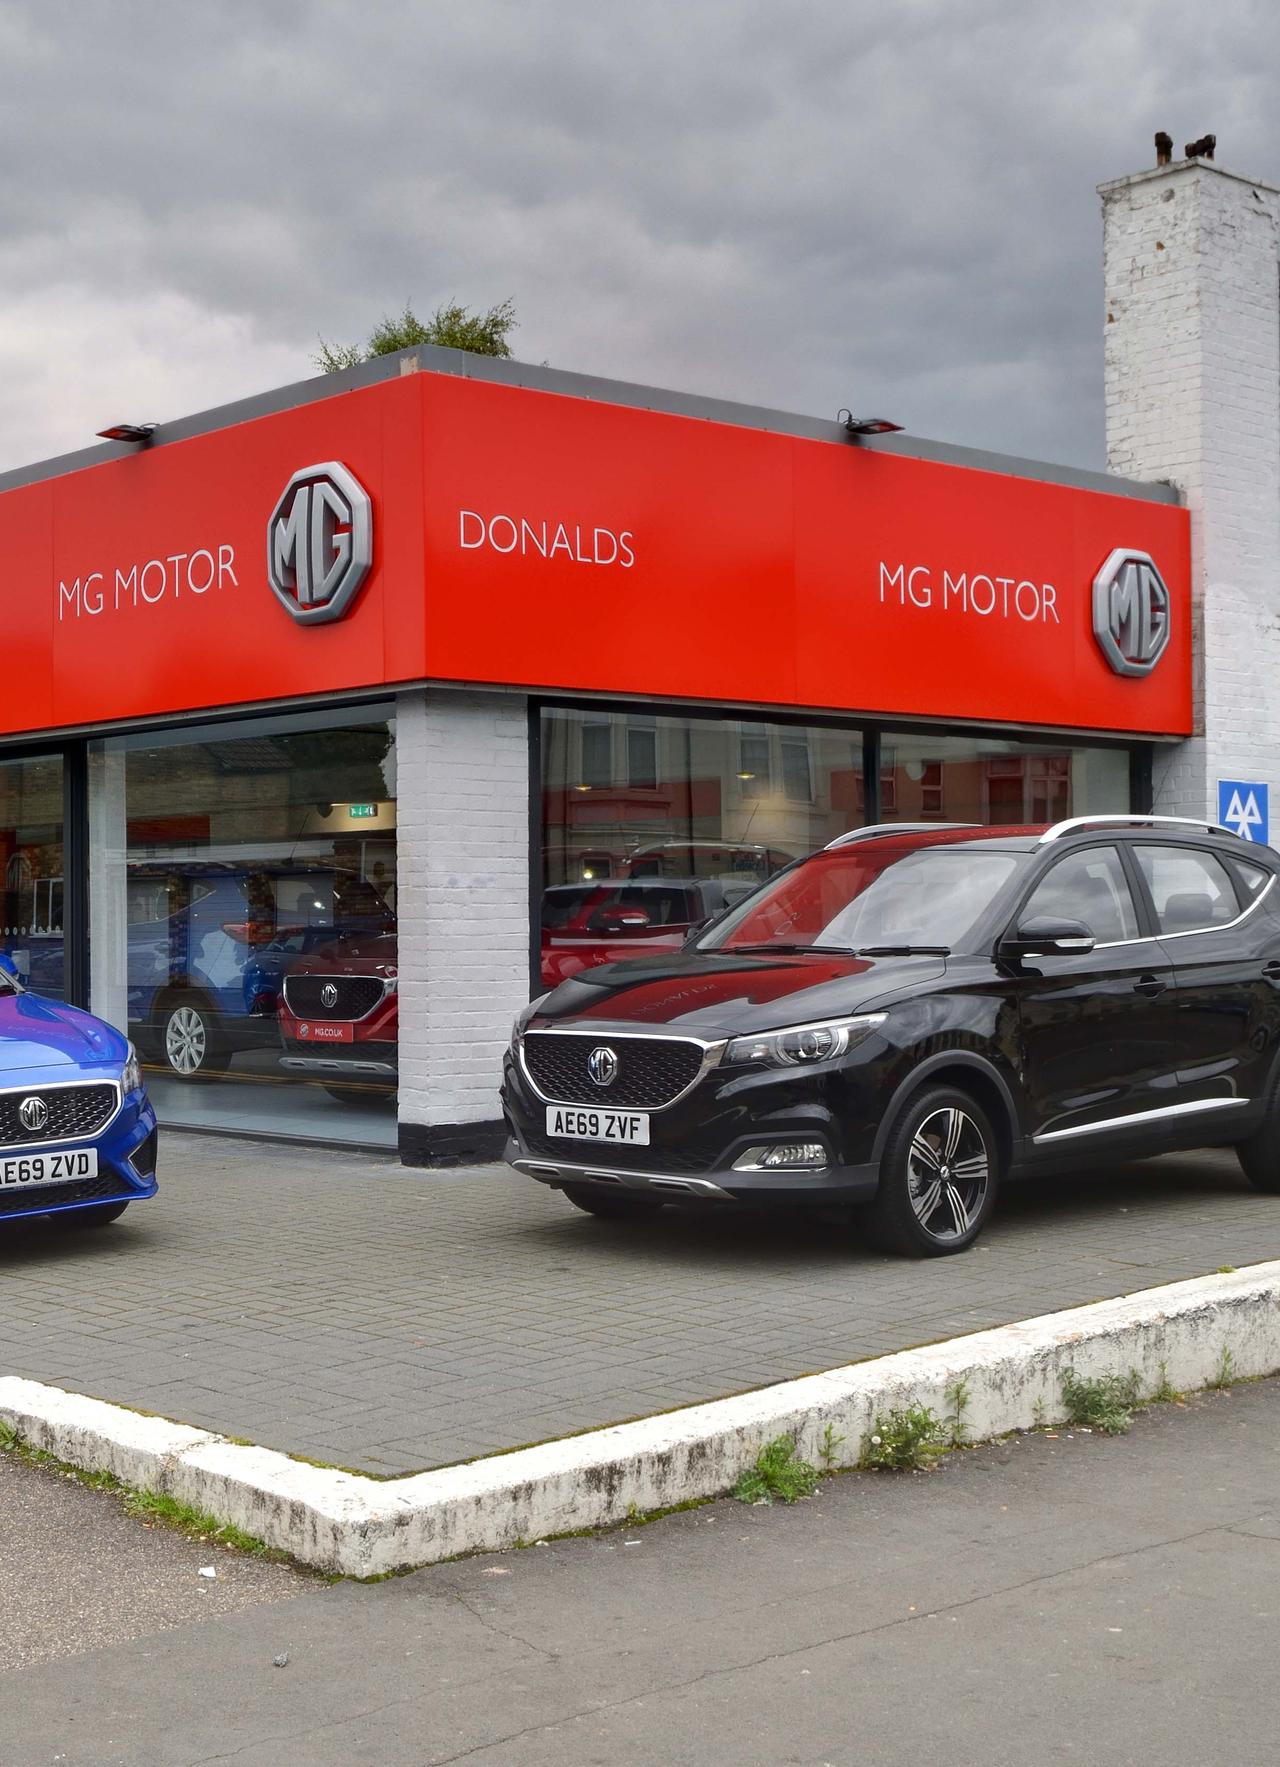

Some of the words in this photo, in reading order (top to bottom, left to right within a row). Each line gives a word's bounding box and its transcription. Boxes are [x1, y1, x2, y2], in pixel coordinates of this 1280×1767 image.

[274, 481, 351, 604] MG
[459, 510, 635, 568] DONALDS
[58, 572, 104, 621] MG
[113, 544, 239, 610] MOTOR
[879, 561, 932, 608] MG
[943, 570, 1060, 624] MOTOR
[1109, 563, 1167, 660] MG
[22, 1099, 46, 1128] MG
[554, 1110, 599, 1137] AE69
[605, 1115, 641, 1140] ZVF
[51, 1153, 89, 1179] ZVD
